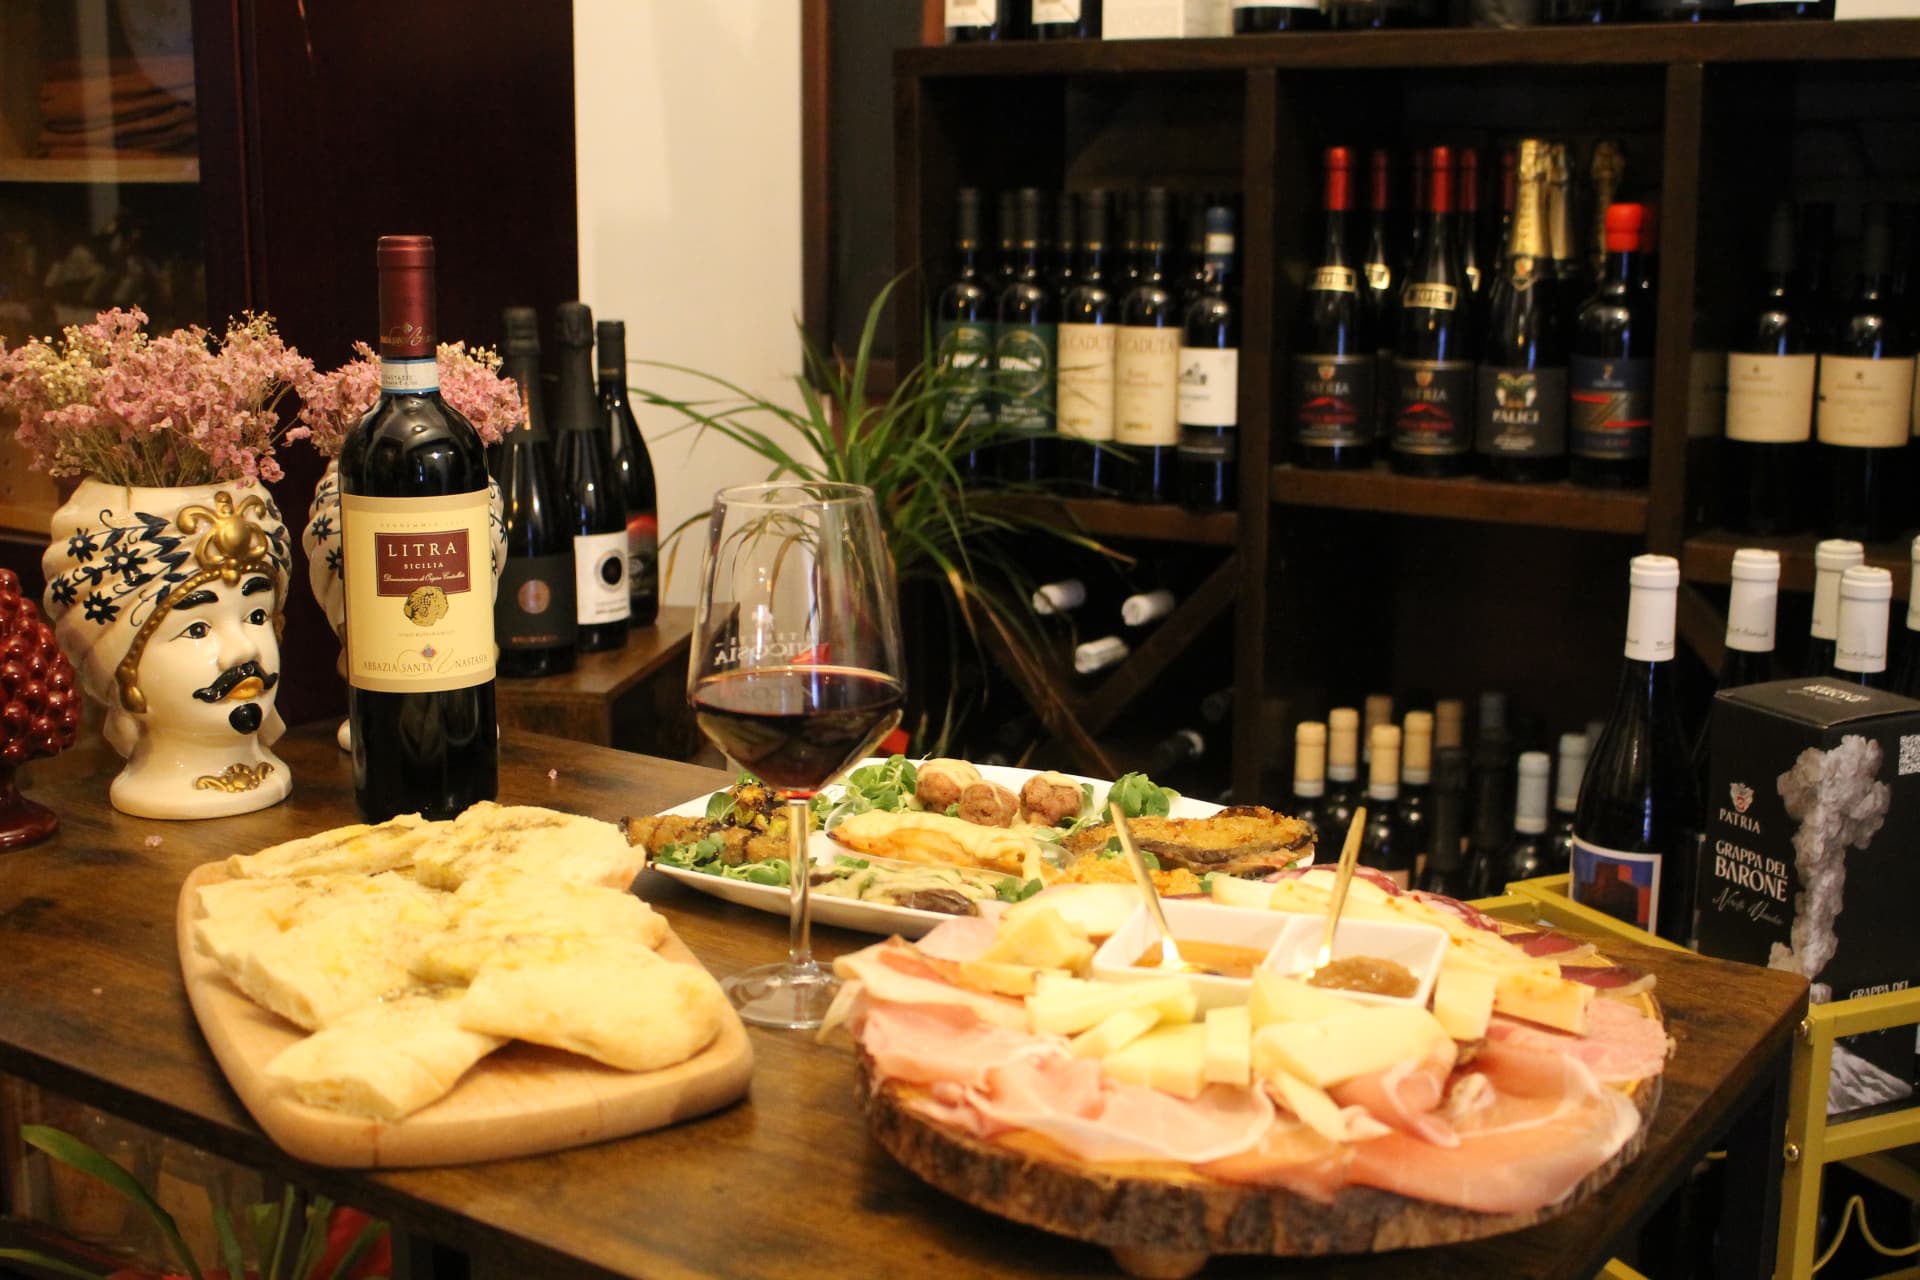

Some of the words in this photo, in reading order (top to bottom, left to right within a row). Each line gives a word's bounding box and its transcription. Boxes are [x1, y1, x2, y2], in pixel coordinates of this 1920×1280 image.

[387, 541, 457, 557] LITRA
[403, 562, 444, 570] SICILIA
[401, 662, 434, 673] SANTA
[1719, 807, 1761, 835] PATRIA
[1715, 839, 1763, 871] GRAPPA
[1765, 857, 1788, 879] DEL
[1714, 855, 1788, 903] BARONE
